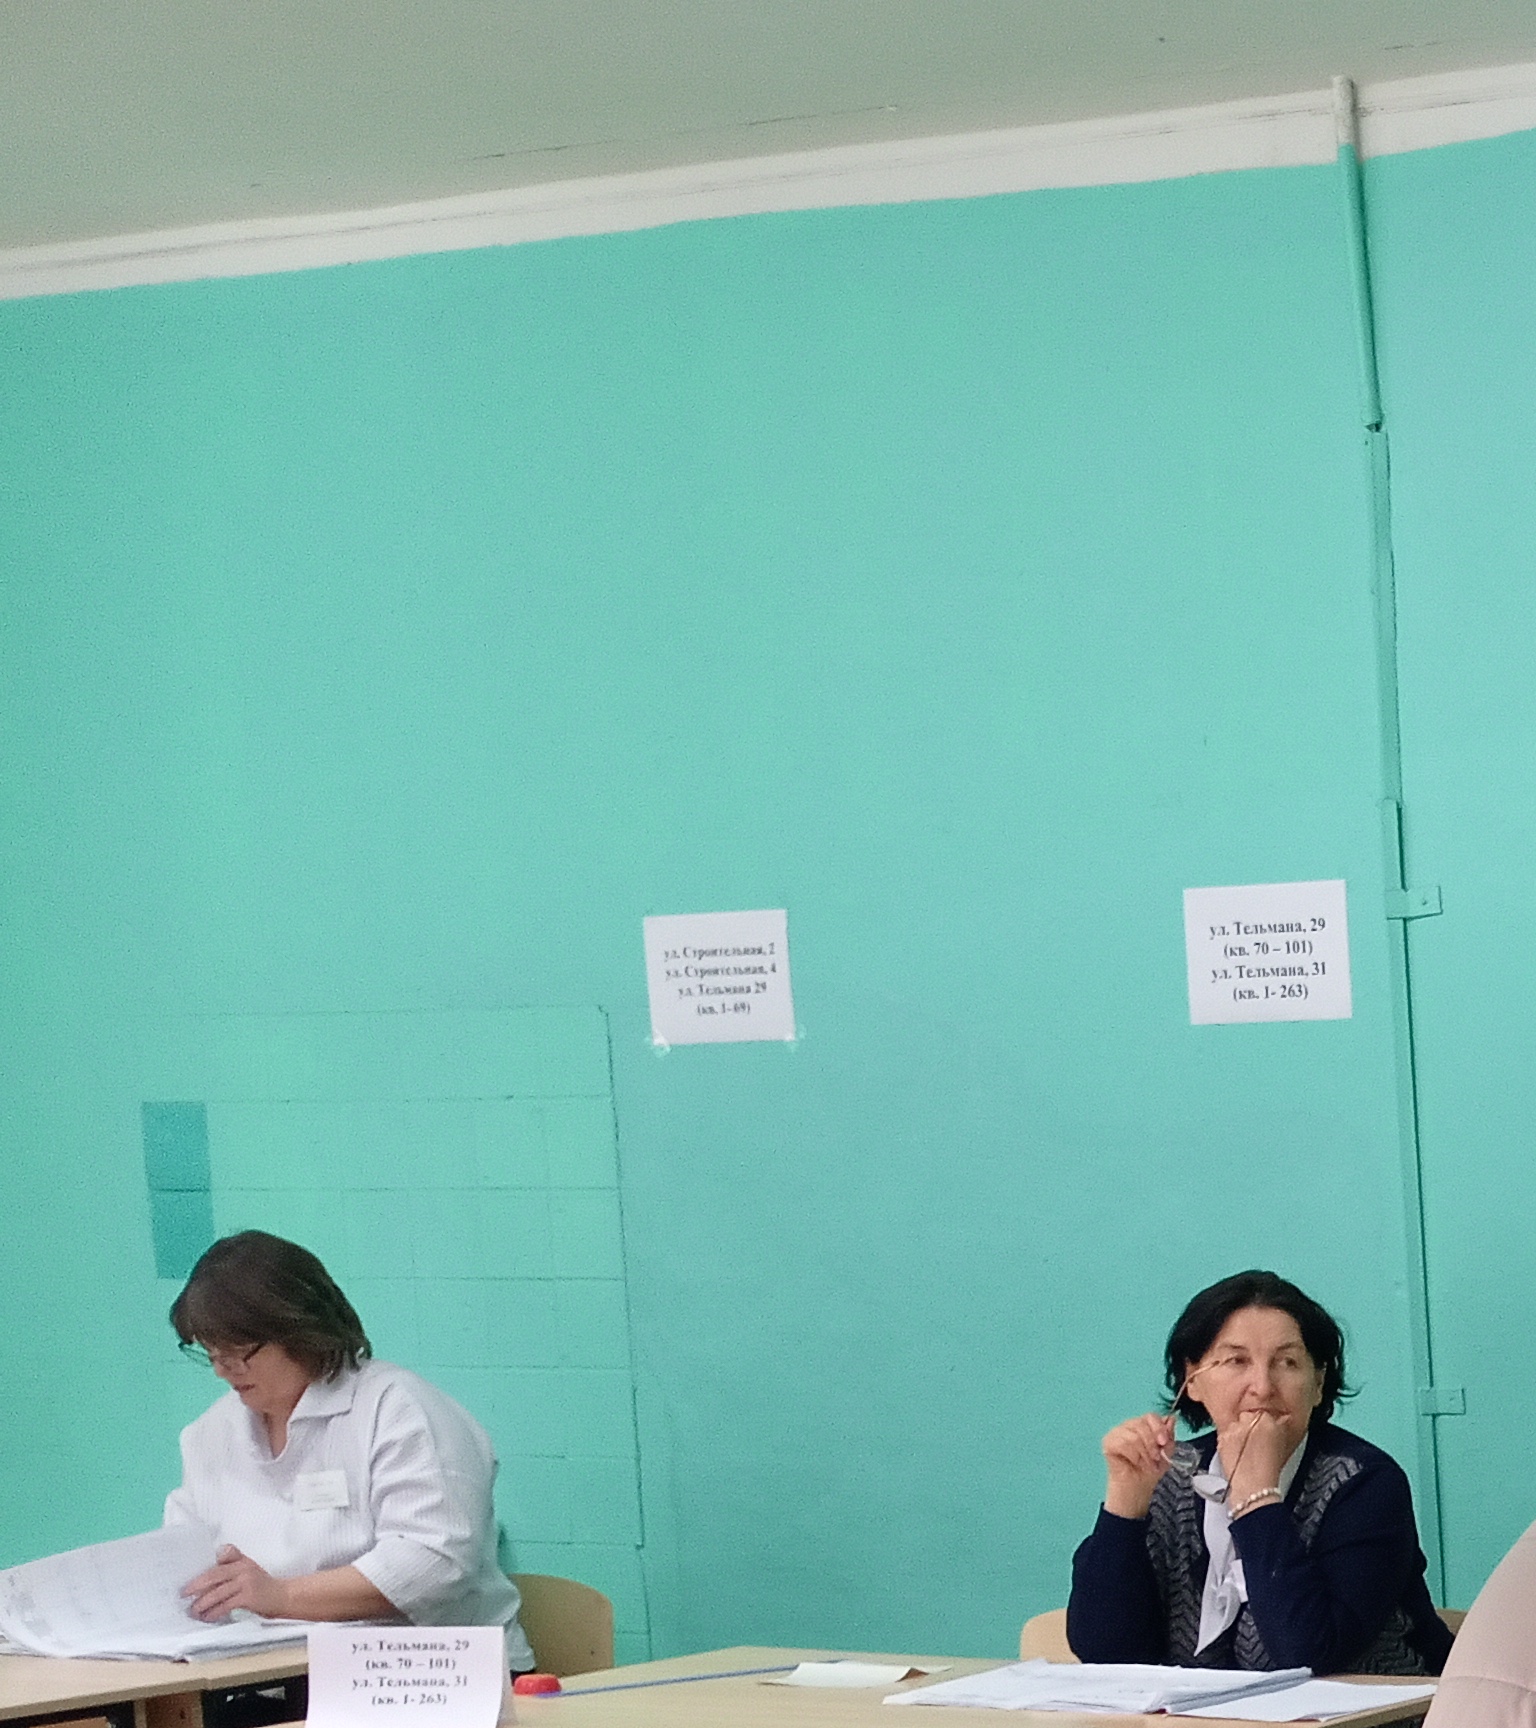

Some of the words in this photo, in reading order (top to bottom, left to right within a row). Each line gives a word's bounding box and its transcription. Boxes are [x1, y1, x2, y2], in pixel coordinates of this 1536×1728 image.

[1209, 926, 1230, 940] ул.
[1233, 921, 1307, 935] Тельмана,
[1310, 917, 1326, 932] 29
[1224, 944, 1249, 959] (кв.
[1253, 941, 1269, 955] 70
[1285, 940, 1313, 956] 101)
[1211, 969, 1232, 983] ул.
[1235, 965, 1309, 979] Тельмана,
[1311, 962, 1326, 976] 31
[1233, 987, 1260, 1002] (кв.
[1280, 984, 1309, 1000] 263)
[352, 1643, 372, 1654] ул.
[377, 1640, 450, 1651] Тельмана,
[455, 1639, 470, 1651] 29
[365, 1660, 392, 1670] (кв.
[397, 1658, 412, 1669] 70
[429, 1658, 456, 1670] 101)
[353, 1679, 373, 1690] ул.
[377, 1676, 450, 1687] Тельмана,
[455, 1675, 467, 1687] 31
[419, 1693, 447, 1705] 263)
